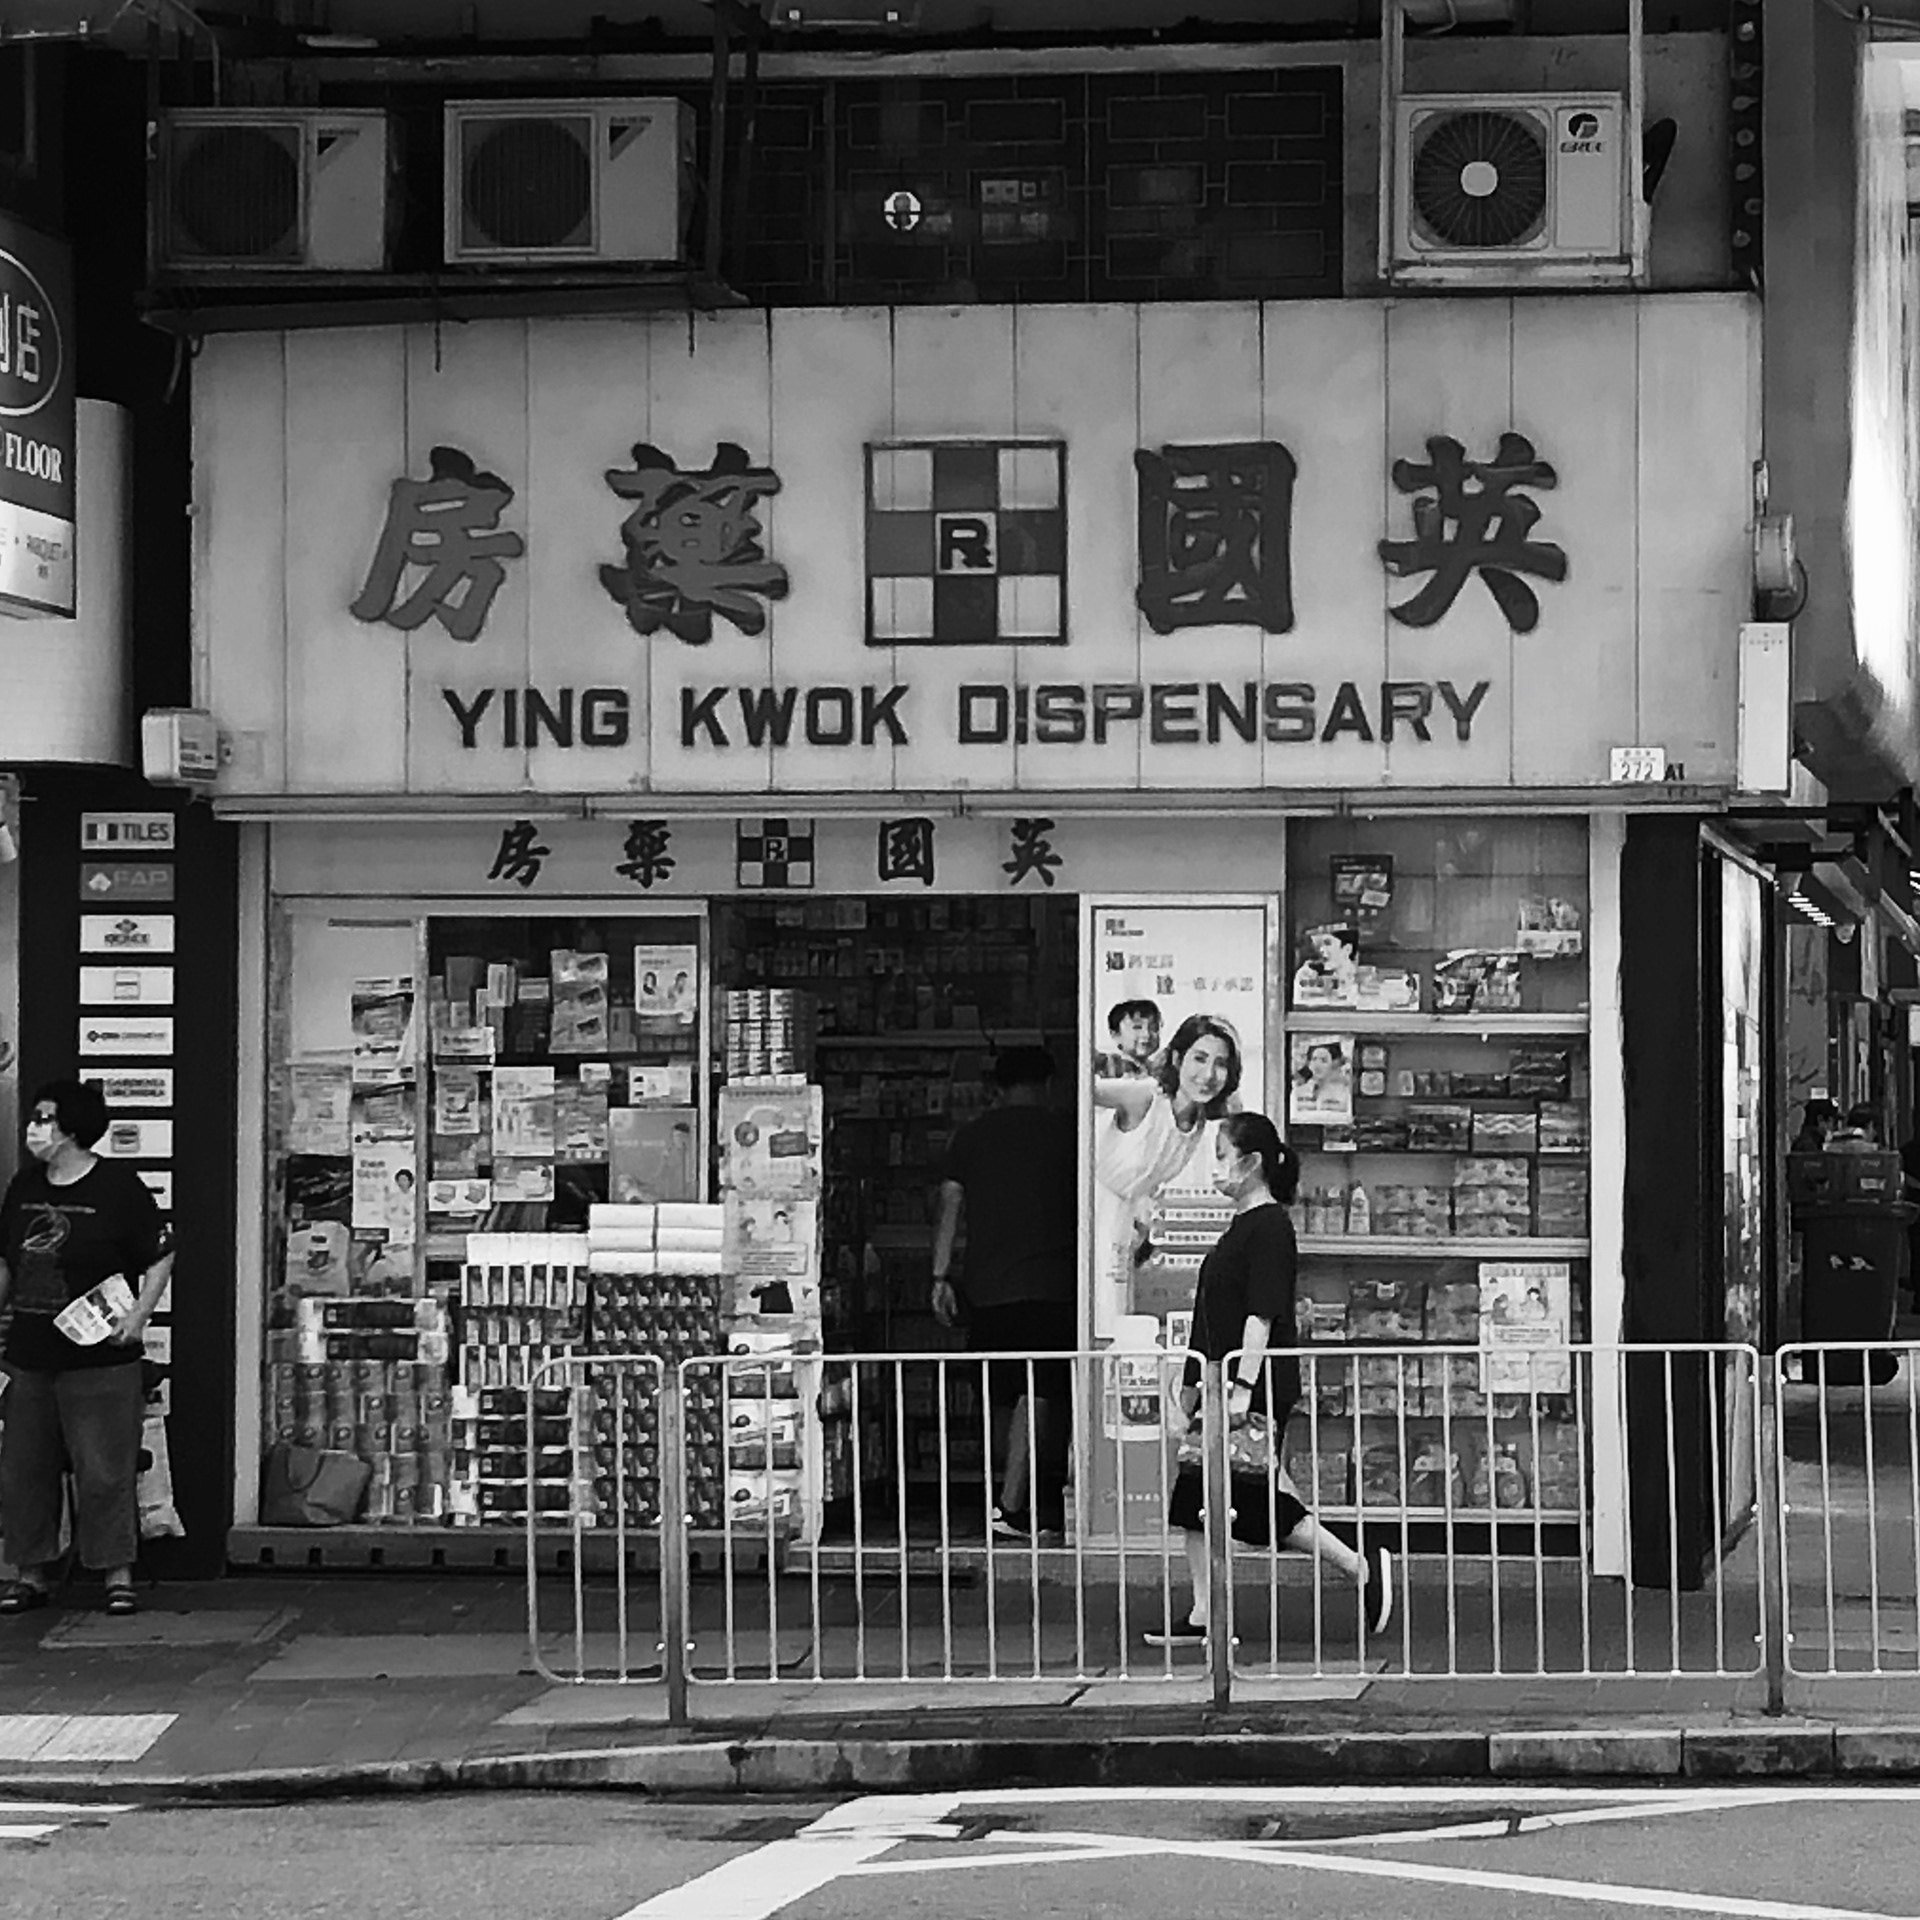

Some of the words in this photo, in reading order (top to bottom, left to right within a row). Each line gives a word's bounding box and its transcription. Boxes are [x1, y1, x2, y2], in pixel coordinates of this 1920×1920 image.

[6, 432, 62, 483] FLOOR
[443, 688, 630, 748] YING
[681, 686, 911, 746] KWOK
[959, 683, 1489, 743] DISPENSARY
[1621, 759, 1653, 781] 272
